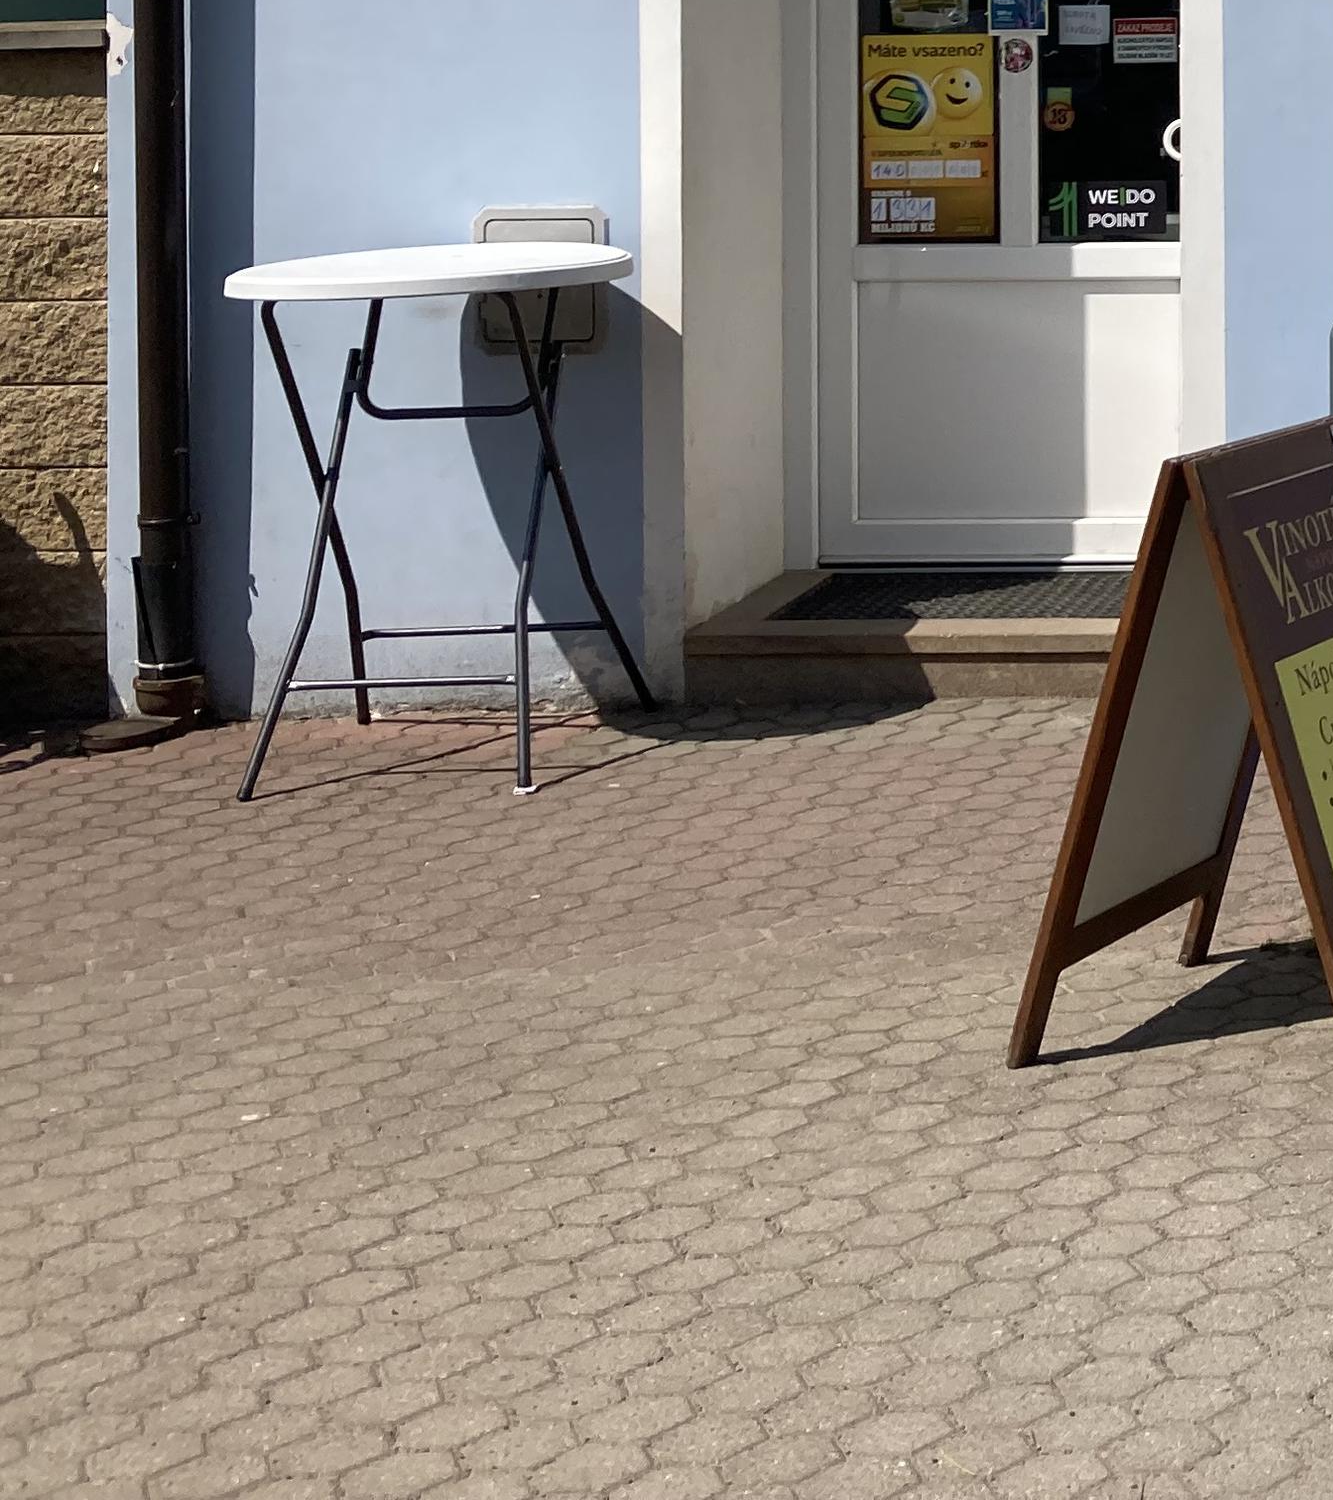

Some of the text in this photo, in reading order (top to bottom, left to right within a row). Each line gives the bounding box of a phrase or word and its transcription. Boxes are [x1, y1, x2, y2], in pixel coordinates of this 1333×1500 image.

[867, 43, 985, 58] Máte vsazeno?
[1088, 212, 1149, 228] POINT
